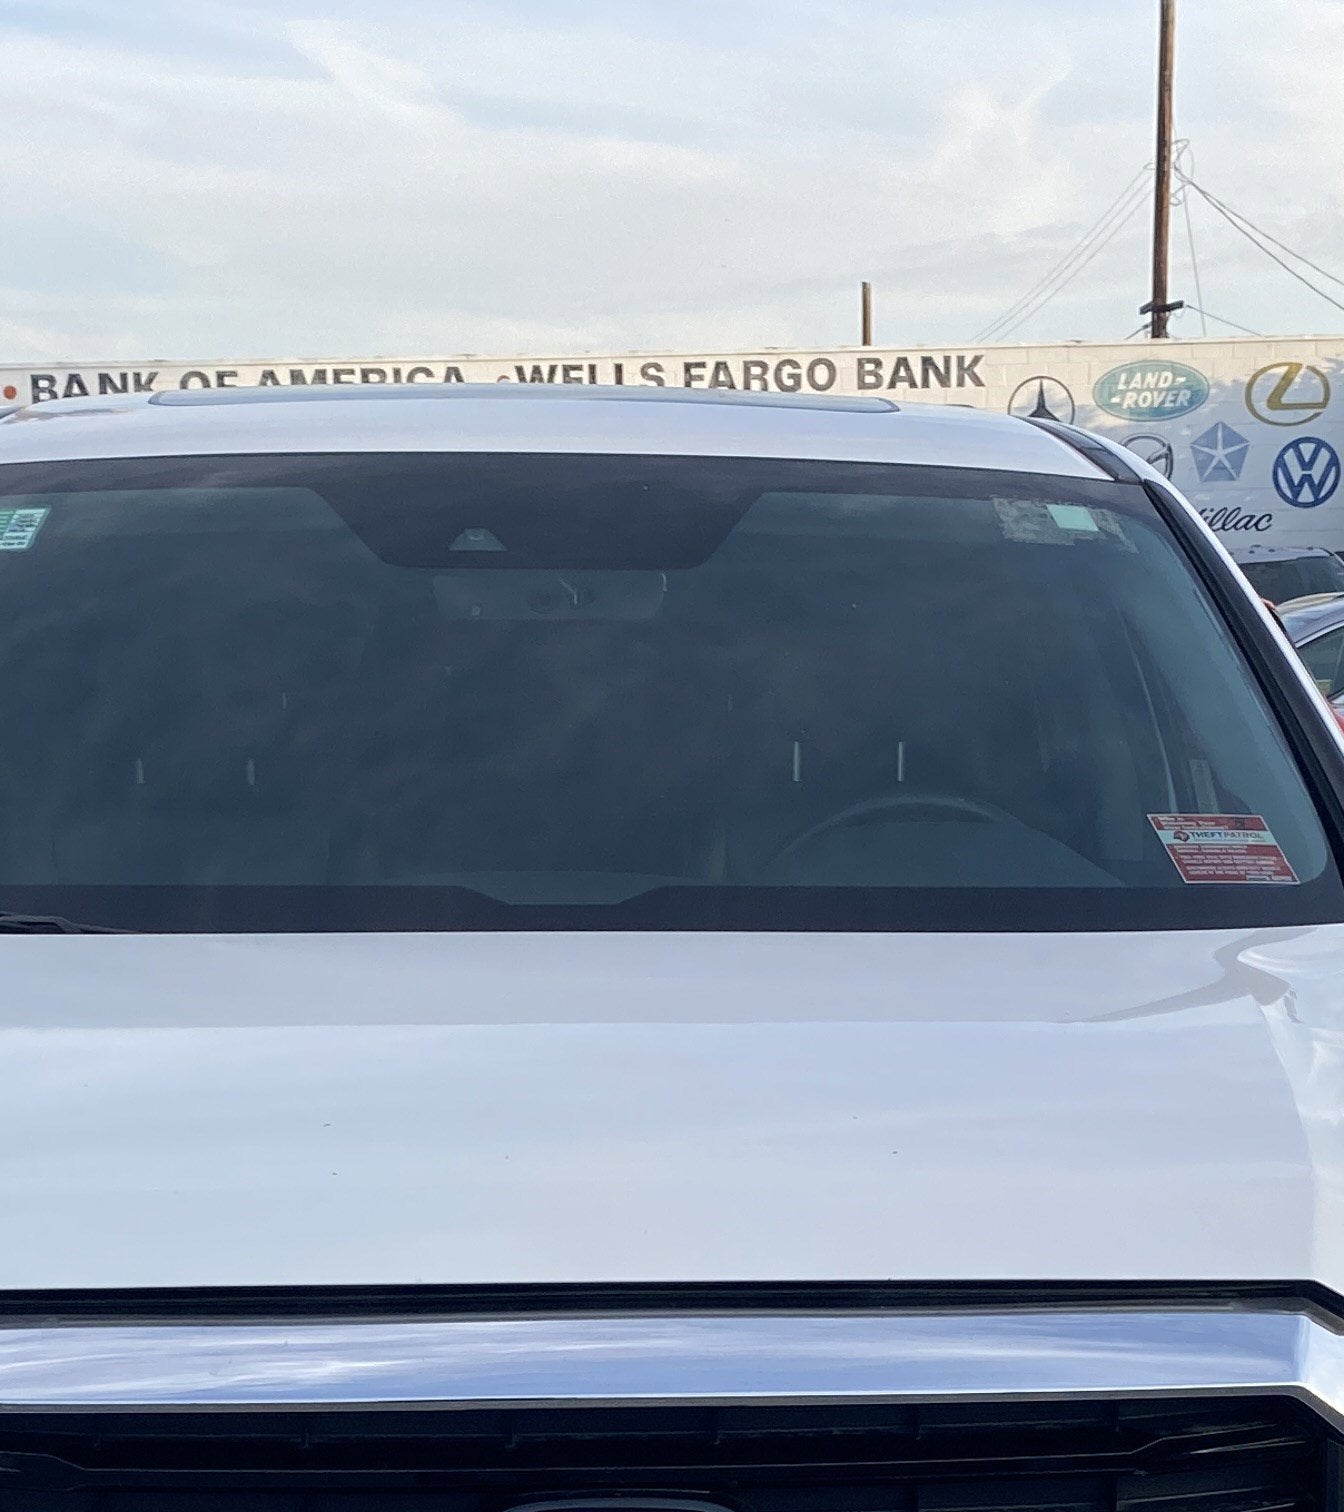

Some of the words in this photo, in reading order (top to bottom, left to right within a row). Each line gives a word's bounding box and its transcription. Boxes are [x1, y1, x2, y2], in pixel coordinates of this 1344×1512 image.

[30, 371, 160, 404] BANK
[683, 357, 837, 391] FARGO
[856, 354, 987, 390] BANK
